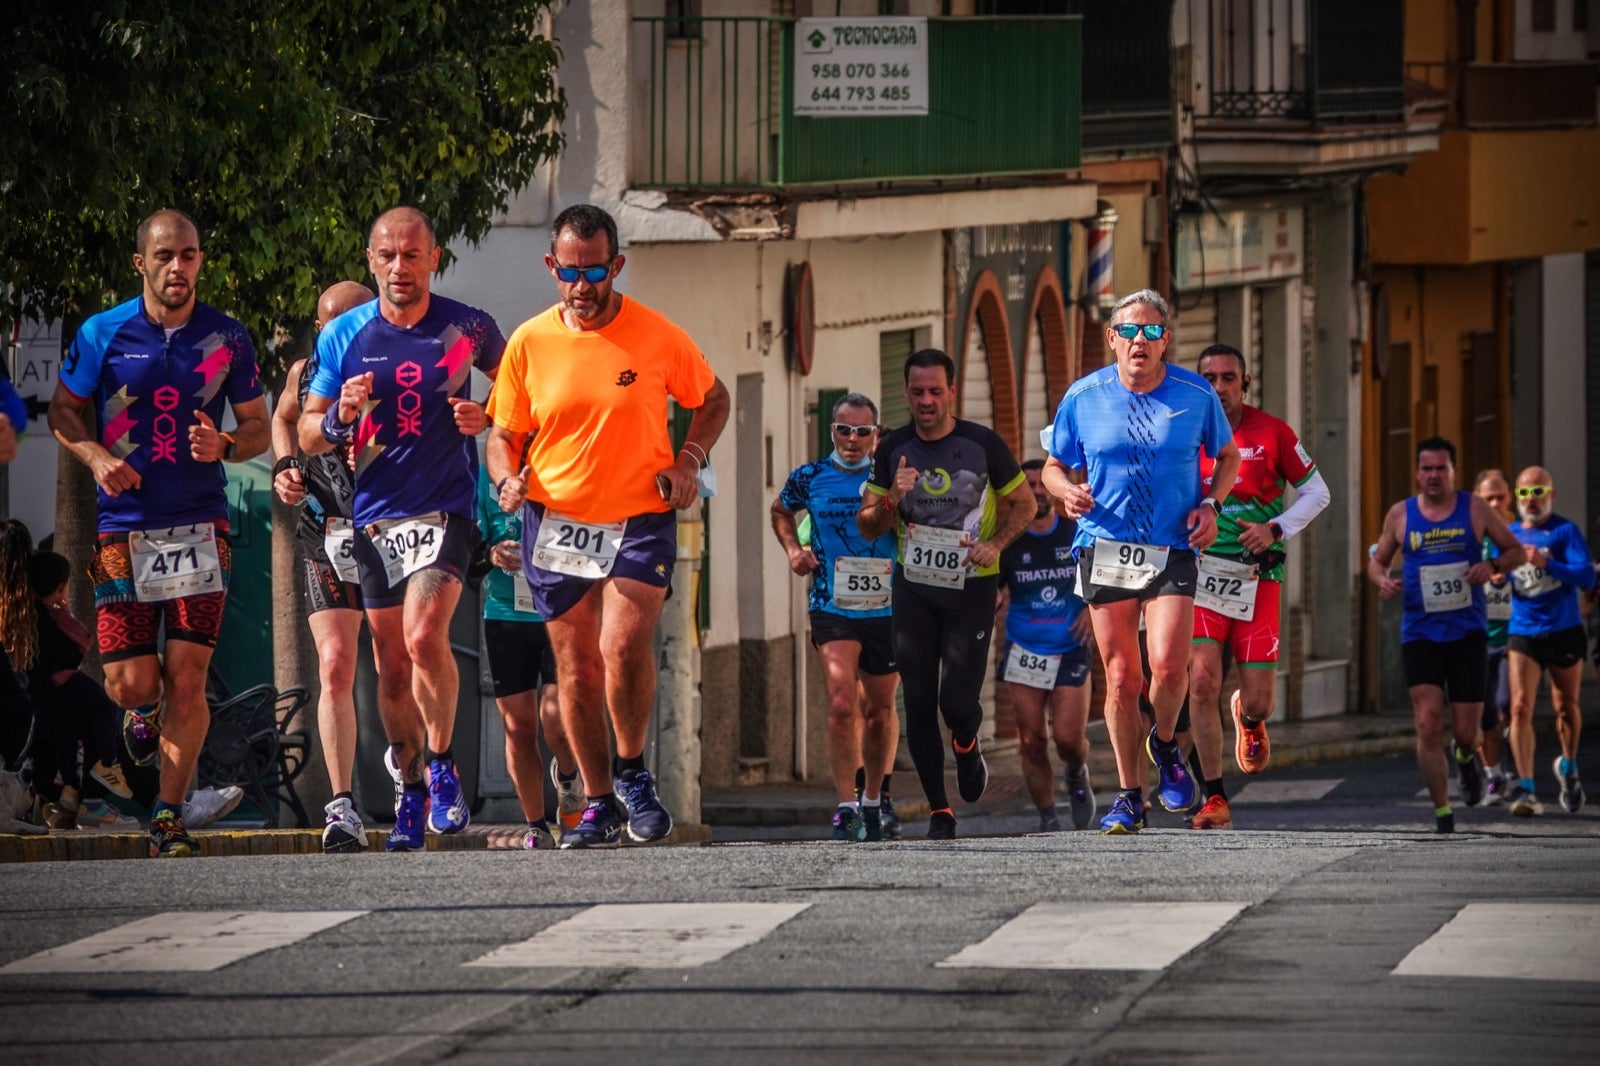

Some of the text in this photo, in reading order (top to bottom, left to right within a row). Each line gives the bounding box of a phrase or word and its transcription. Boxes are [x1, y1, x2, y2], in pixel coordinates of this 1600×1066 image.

[833, 25, 917, 46] TECNOCASA
[812, 63, 910, 79] 958 070 366
[811, 86, 910, 101] 644 793 485
[385, 527, 436, 560] 3004
[556, 524, 606, 554] 201
[151, 546, 198, 575] 471
[912, 547, 959, 570] 3108
[1119, 544, 1146, 567] 90
[847, 575, 882, 592] 533
[1204, 575, 1243, 597] 672
[1432, 578, 1463, 596] 339
[1019, 654, 1048, 673] 834
